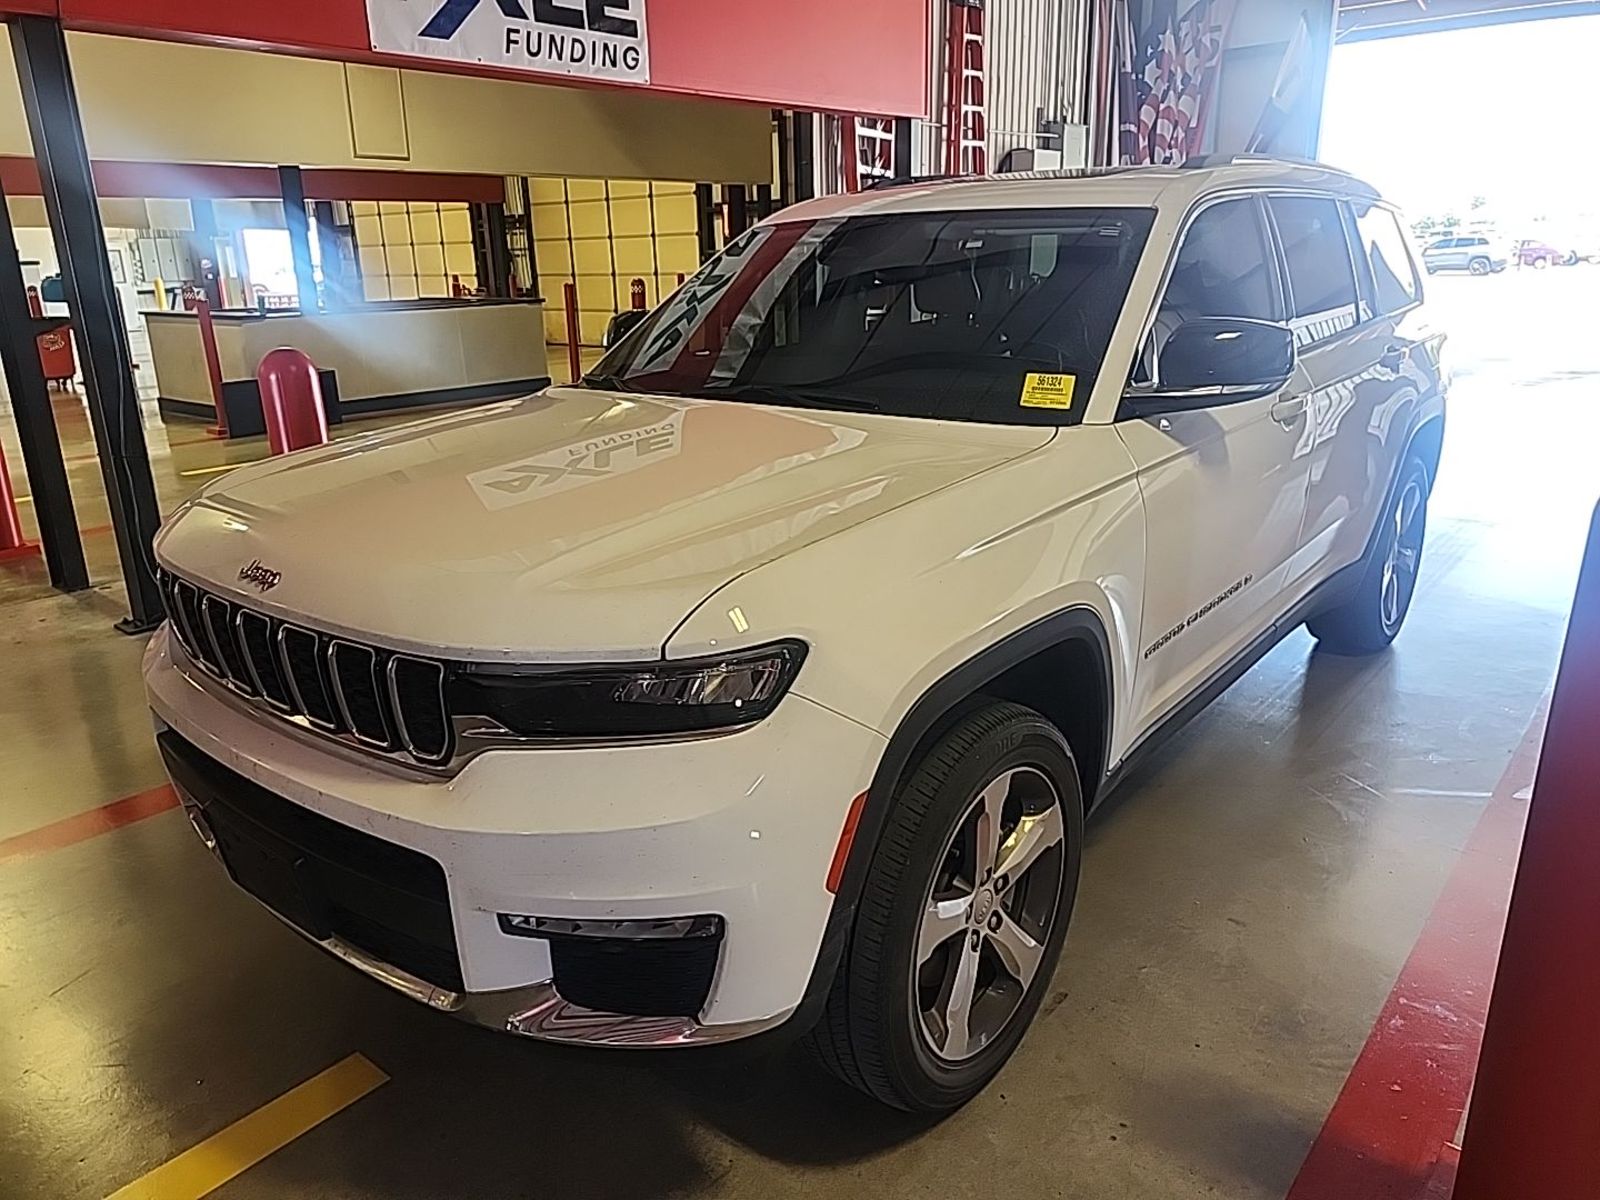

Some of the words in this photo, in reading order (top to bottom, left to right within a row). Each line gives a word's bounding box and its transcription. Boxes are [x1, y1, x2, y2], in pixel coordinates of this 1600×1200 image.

[402, 0, 638, 40] LE
[505, 27, 640, 70] FUNDING
[240, 559, 282, 593] Jeep
